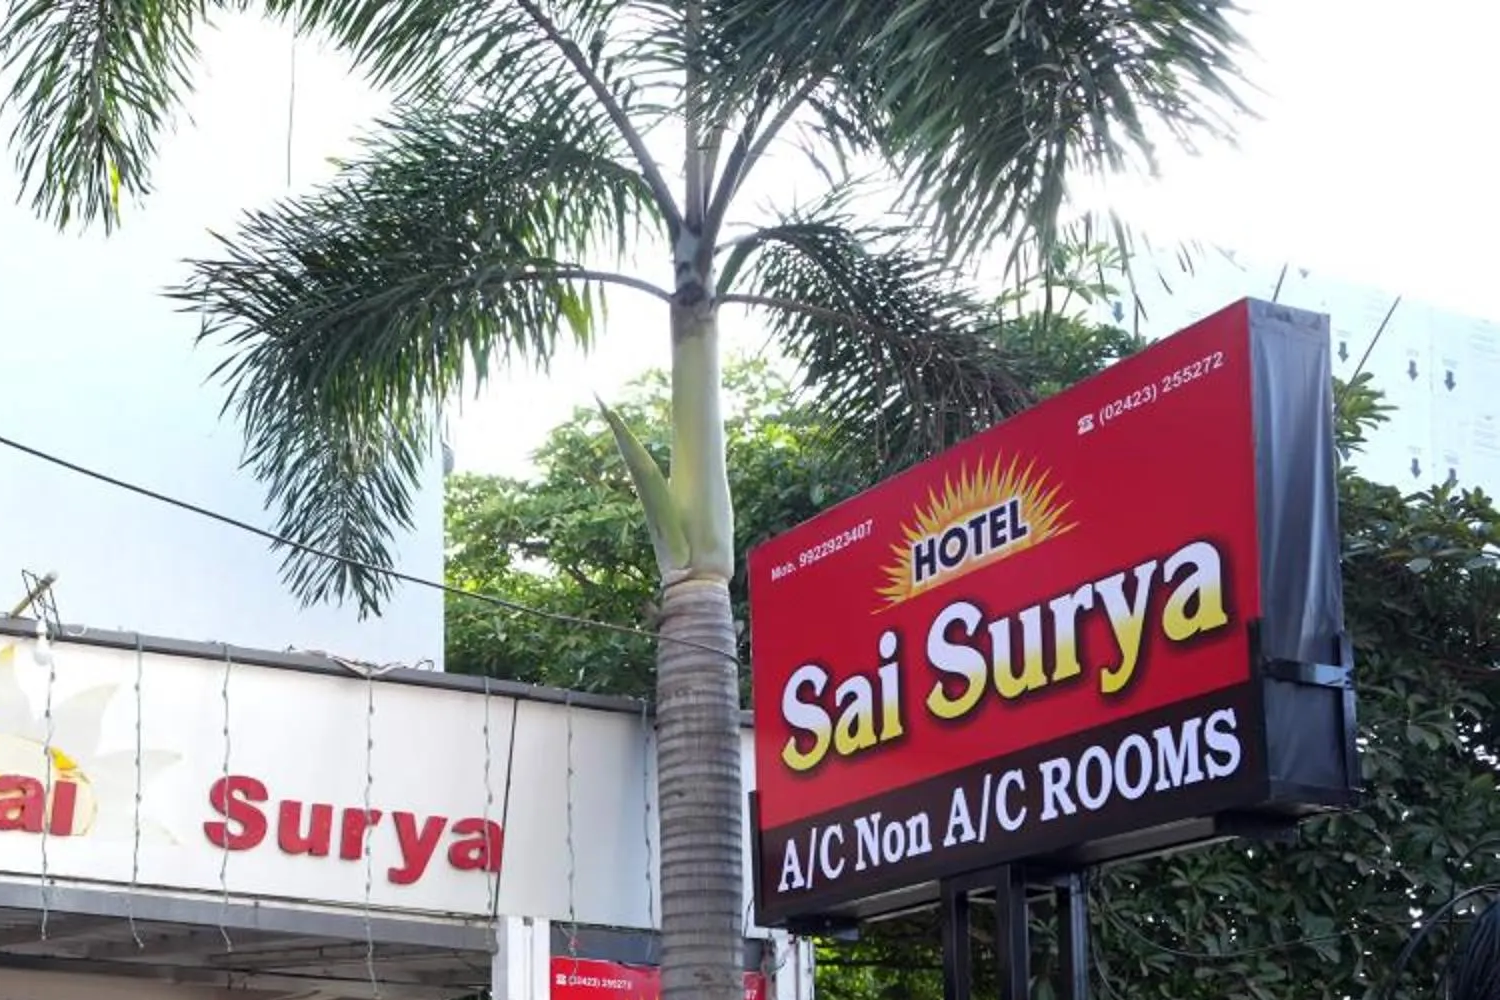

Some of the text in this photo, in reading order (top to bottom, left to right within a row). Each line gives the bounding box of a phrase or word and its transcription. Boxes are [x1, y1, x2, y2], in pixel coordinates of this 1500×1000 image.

[1099, 351, 1224, 427] (02423) 255272
[799, 518, 874, 569] 9922923407
[913, 500, 1029, 583] HOTEL
[781, 540, 1228, 772] Sai Surya
[202, 774, 505, 885] Surya
[777, 707, 1242, 893] A/C Non A/C ROOMS
